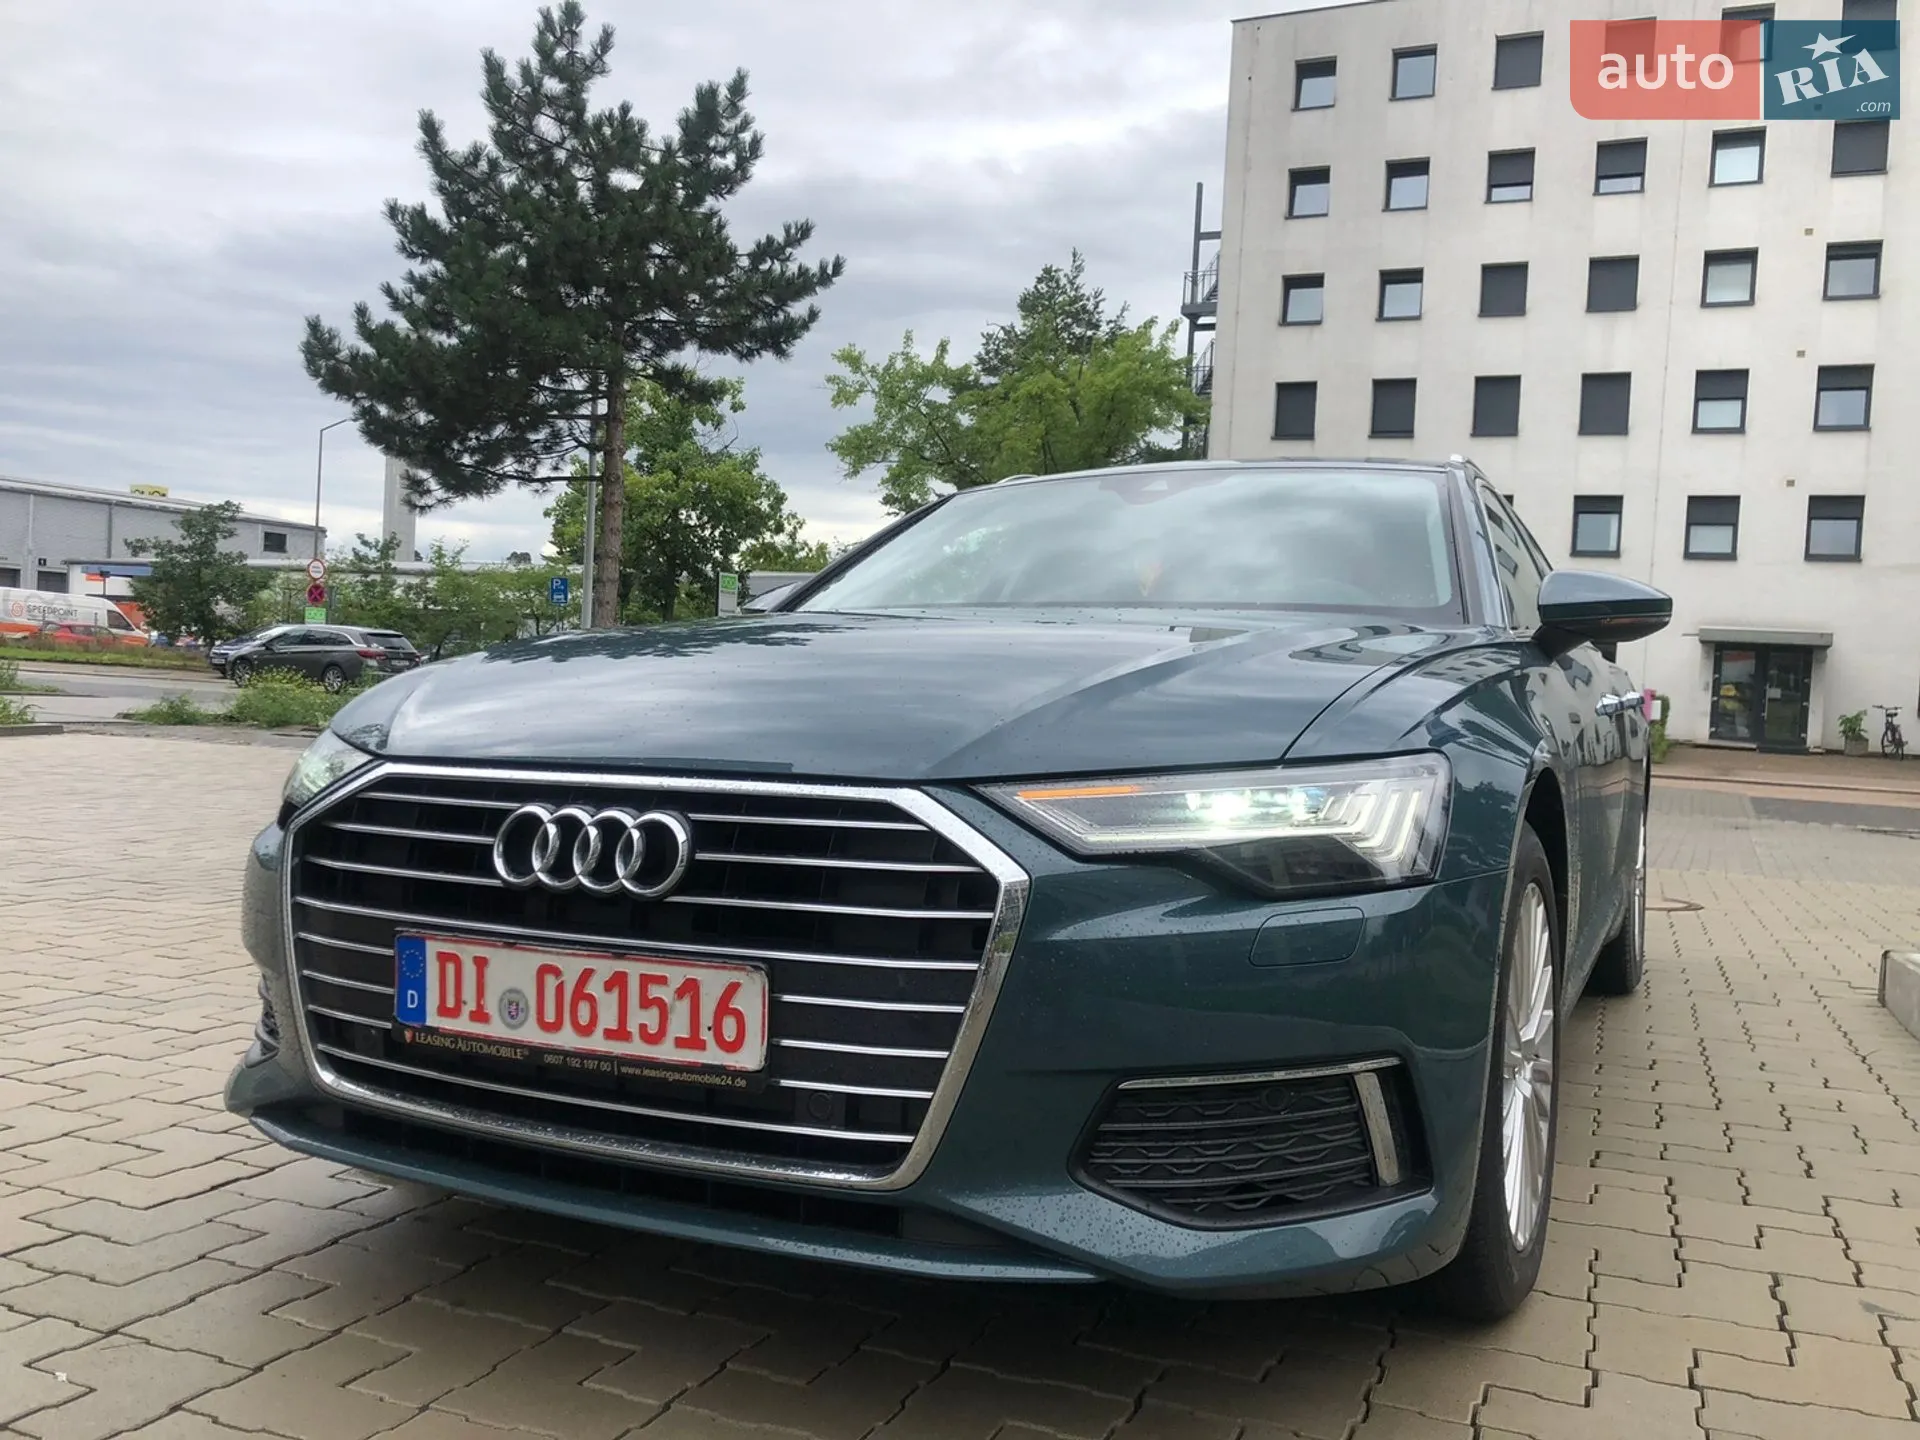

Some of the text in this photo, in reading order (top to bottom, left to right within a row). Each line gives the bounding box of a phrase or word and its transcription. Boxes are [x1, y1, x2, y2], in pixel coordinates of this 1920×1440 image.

[553, 578, 562, 590] P
[27, 603, 79, 618] SPEEDPOINT
[407, 989, 418, 1008] D
[436, 949, 746, 1053] DI 061516
[415, 1031, 456, 1049] LEASING
[620, 1065, 747, 1088] www.leasingautomobile24.de
